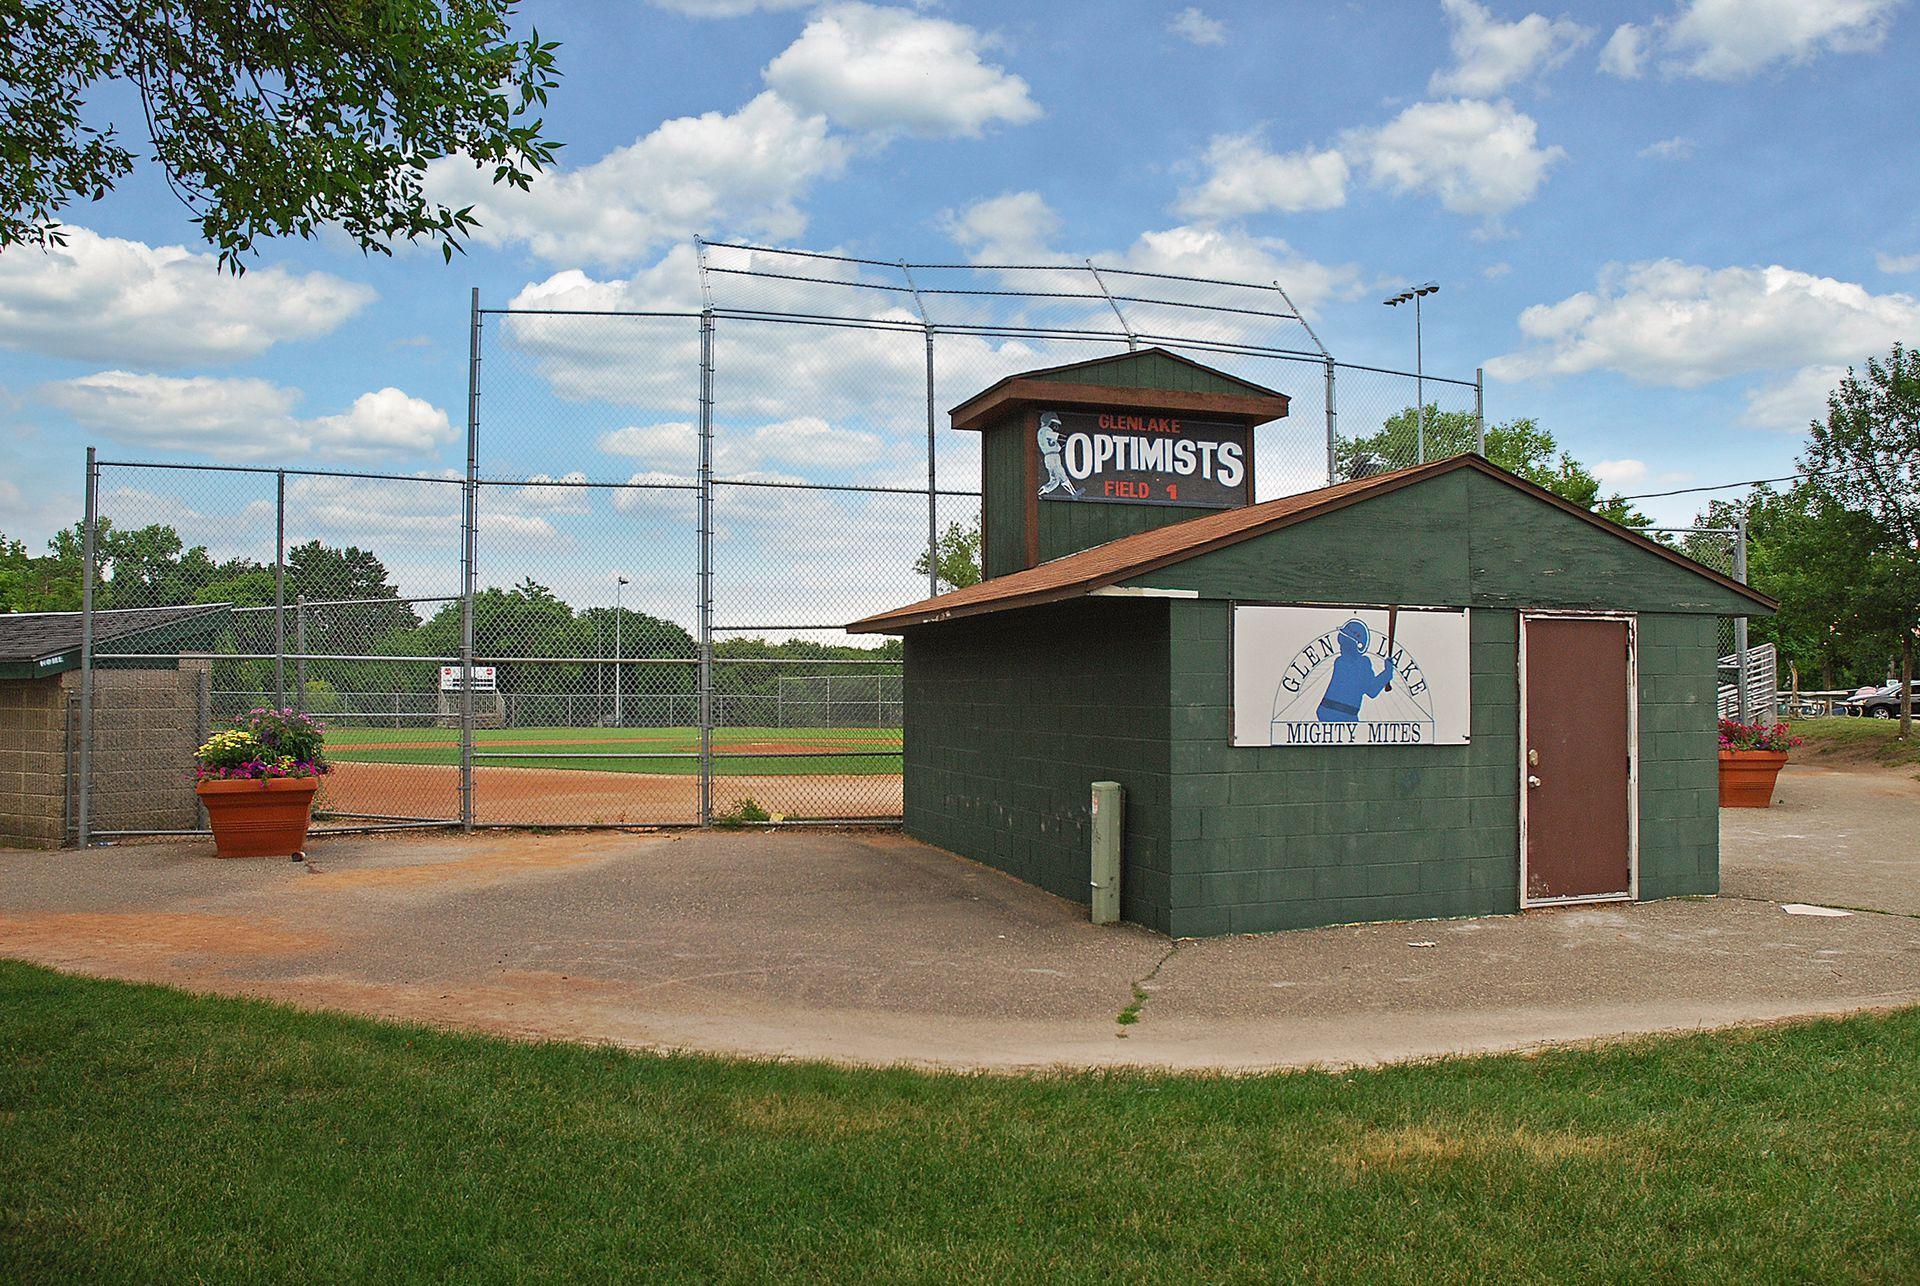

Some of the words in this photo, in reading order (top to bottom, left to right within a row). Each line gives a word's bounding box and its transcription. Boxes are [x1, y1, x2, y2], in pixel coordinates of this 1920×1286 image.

[1098, 413, 1181, 434] GLENLAKE
[1064, 432, 1245, 488] OPTIMISTS
[1104, 480, 1150, 499] FIELD
[1166, 483, 1178, 501] 1
[39, 656, 64, 667] HOME
[1281, 634, 1337, 693] GLEN
[1376, 636, 1428, 697] LAKE
[1286, 722, 1359, 744] MIGHTY
[1367, 722, 1422, 743] MITES
